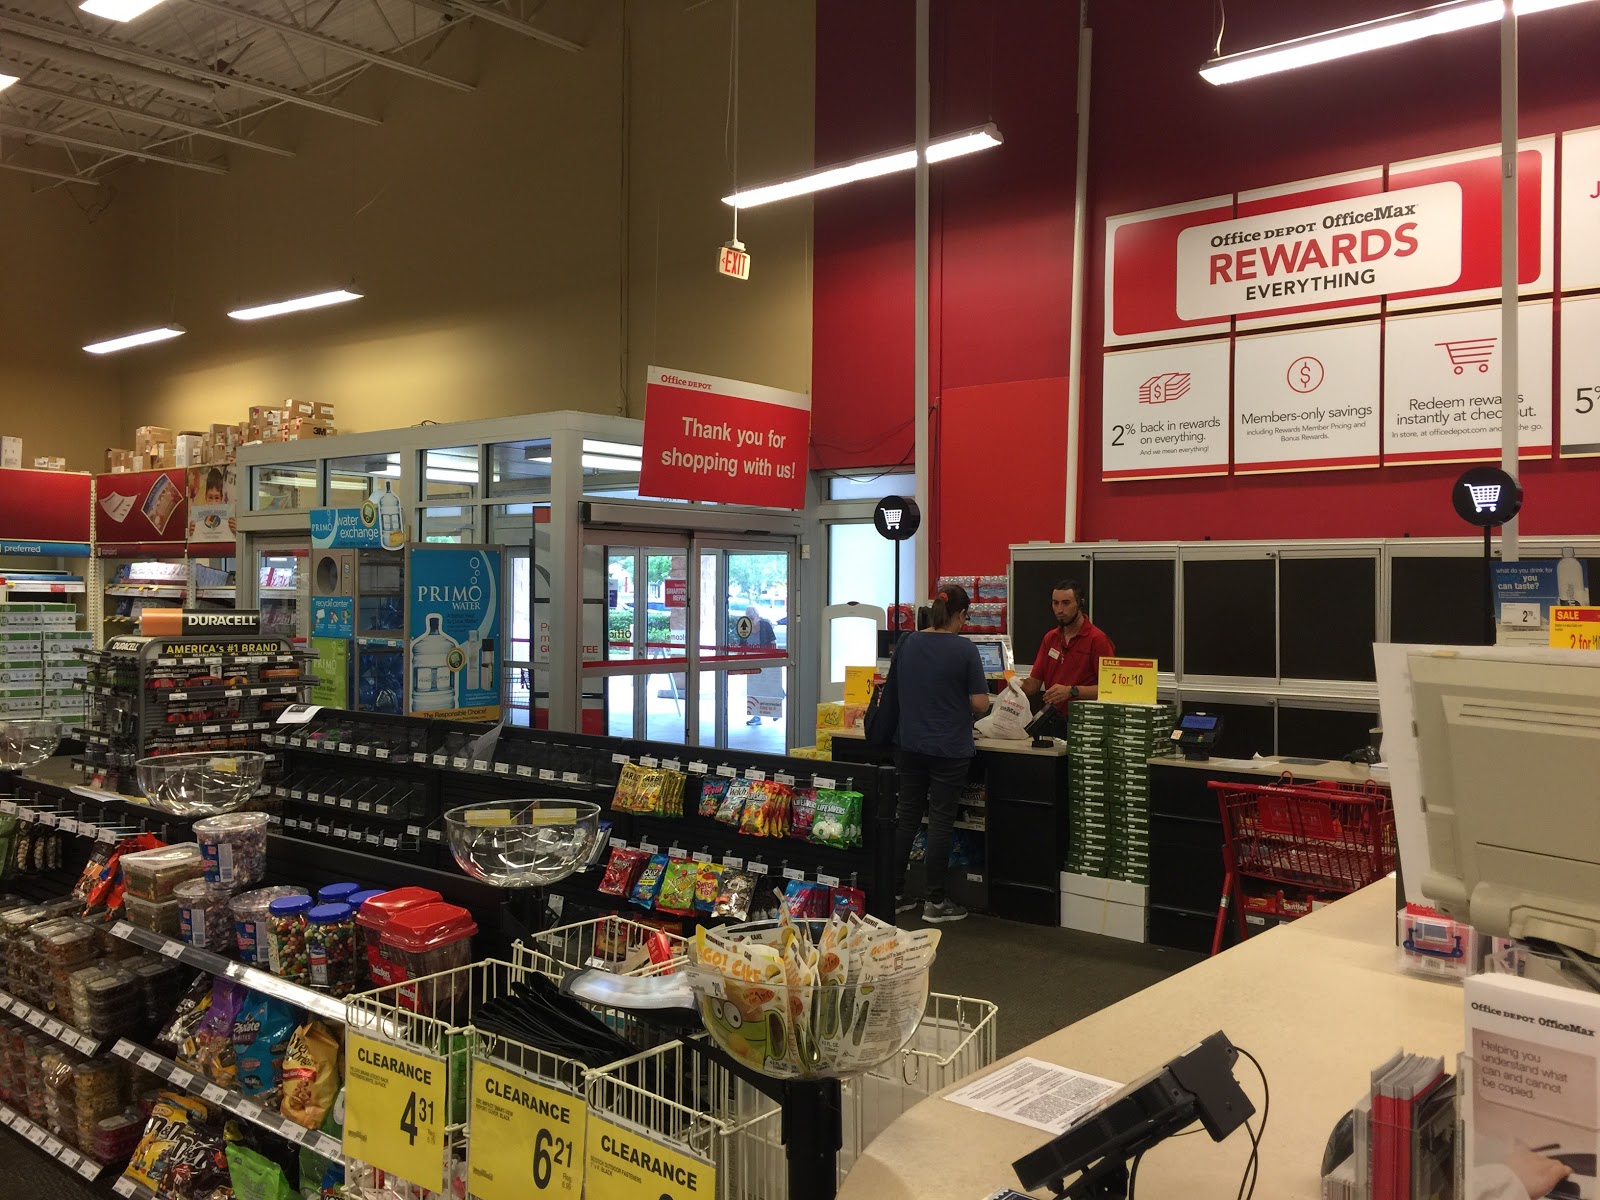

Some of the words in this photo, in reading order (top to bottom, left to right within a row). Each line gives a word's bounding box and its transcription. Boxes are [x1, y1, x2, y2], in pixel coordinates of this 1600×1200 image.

[1210, 231, 1262, 248] Office
[1264, 222, 1317, 239] DEPOT
[1322, 204, 1417, 229] OfficeMax
[1209, 222, 1419, 285] REWARDS
[725, 250, 747, 277] EXIT
[1246, 268, 1376, 300] EVERYTHING
[660, 374, 687, 386] Office
[687, 380, 712, 390] DEPOT
[1409, 396, 1465, 411] Redeem
[1469, 393, 1524, 407] rewas
[1241, 407, 1326, 425] Members-only
[1328, 405, 1373, 419] savings
[1396, 410, 1450, 426] instantly
[1453, 410, 1467, 422] at
[1470, 407, 1537, 421] checut.
[313, 426, 327, 436] 3M
[682, 416, 732, 442] Thank
[736, 428, 763, 448] you
[768, 429, 787, 449] for
[1140, 420, 1164, 433] back
[1167, 420, 1176, 431] in
[1179, 416, 1221, 430] rewards
[1247, 428, 1274, 436] including
[1274, 425, 1301, 434] Rewards
[1302, 424, 1329, 432] Member
[1330, 422, 1352, 431] Pricing
[1353, 420, 1367, 428] and
[1429, 426, 1488, 437] officedepot.com
[1111, 423, 1136, 446] 2%
[1140, 436, 1152, 445] on
[1154, 431, 1206, 445] everything.
[1301, 432, 1329, 441] Rewards.
[1178, 445, 1210, 454] everything!
[661, 447, 738, 478] shopping
[743, 457, 772, 477] with
[776, 461, 796, 480] us!
[311, 523, 333, 532] PRIMO
[338, 515, 359, 526] water
[340, 526, 379, 540] exchange
[4, 544, 41, 554] preferred
[417, 585, 482, 602] PRIMO
[1514, 582, 1540, 590] taste?
[316, 600, 332, 608] recycle
[333, 600, 348, 608] center
[452, 601, 481, 610] WATER
[188, 615, 257, 626] DURACELL
[1557, 611, 1580, 620] SALE
[112, 642, 140, 651] DURACELL
[166, 644, 225, 654] AMERICA's
[227, 643, 239, 652] #1
[241, 643, 278, 652] BRAND
[1112, 673, 1117, 684] 2
[1118, 673, 1130, 685] for
[1131, 674, 1144, 686] $10
[434, 709, 467, 718] Responsible
[467, 708, 487, 716] Choice!
[1283, 903, 1308, 911] Skittles
[702, 947, 729, 972] GO!
[1470, 1001, 1502, 1016] Office
[1503, 1010, 1536, 1024] DEPOT
[1538, 1016, 1596, 1037] OfficeMax
[1481, 1039, 1519, 1060] Helping
[1521, 1051, 1541, 1063] you
[357, 1047, 432, 1086] CLEARANCE
[1481, 1054, 1539, 1076] understand
[1541, 1067, 1568, 1083] what
[1481, 1065, 1501, 1077] can
[1503, 1070, 1523, 1084] and
[1525, 1076, 1562, 1094] cannot
[1482, 1077, 1496, 1089] be
[1498, 1082, 1536, 1100] copied.
[485, 1078, 570, 1124] CLEARANCE
[600, 1134, 697, 1192] CLEARANCE
